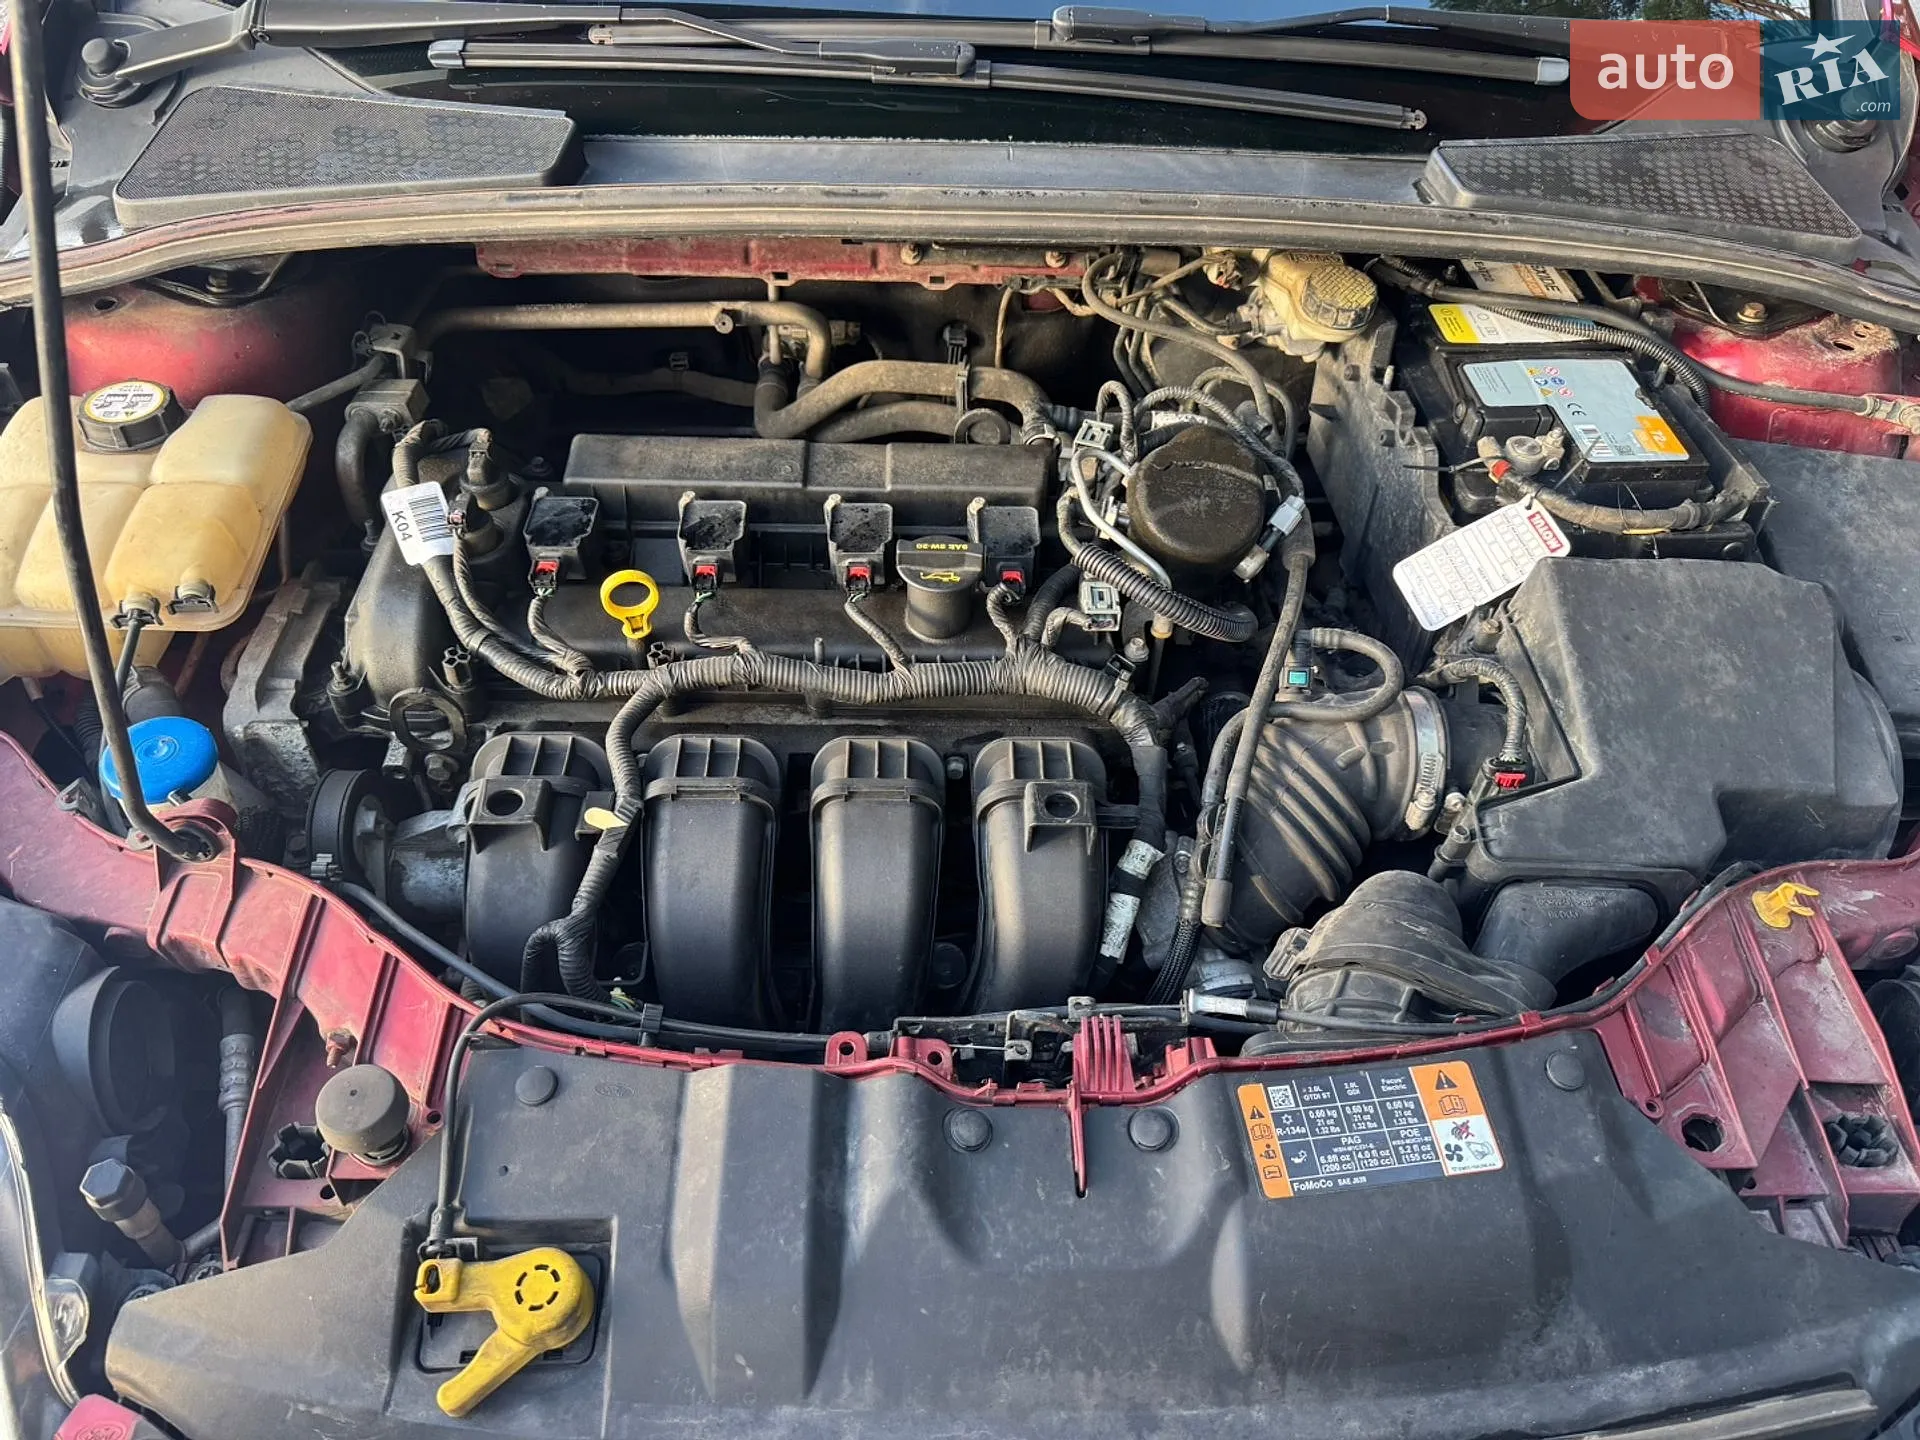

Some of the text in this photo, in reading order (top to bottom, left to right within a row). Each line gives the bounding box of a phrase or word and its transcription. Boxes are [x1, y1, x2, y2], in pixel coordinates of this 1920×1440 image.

[392, 510, 412, 541] K04
[1530, 513, 1562, 552] MOTUL
[1363, 1104, 1374, 1113] kg
[1403, 1100, 1415, 1109] kg
[1326, 1108, 1337, 1118] kg
[1276, 1126, 1306, 1136] R-134a
[1400, 1129, 1421, 1138] POE
[1341, 1136, 1362, 1145] PAG
[1293, 1179, 1333, 1192] FoMoCo
